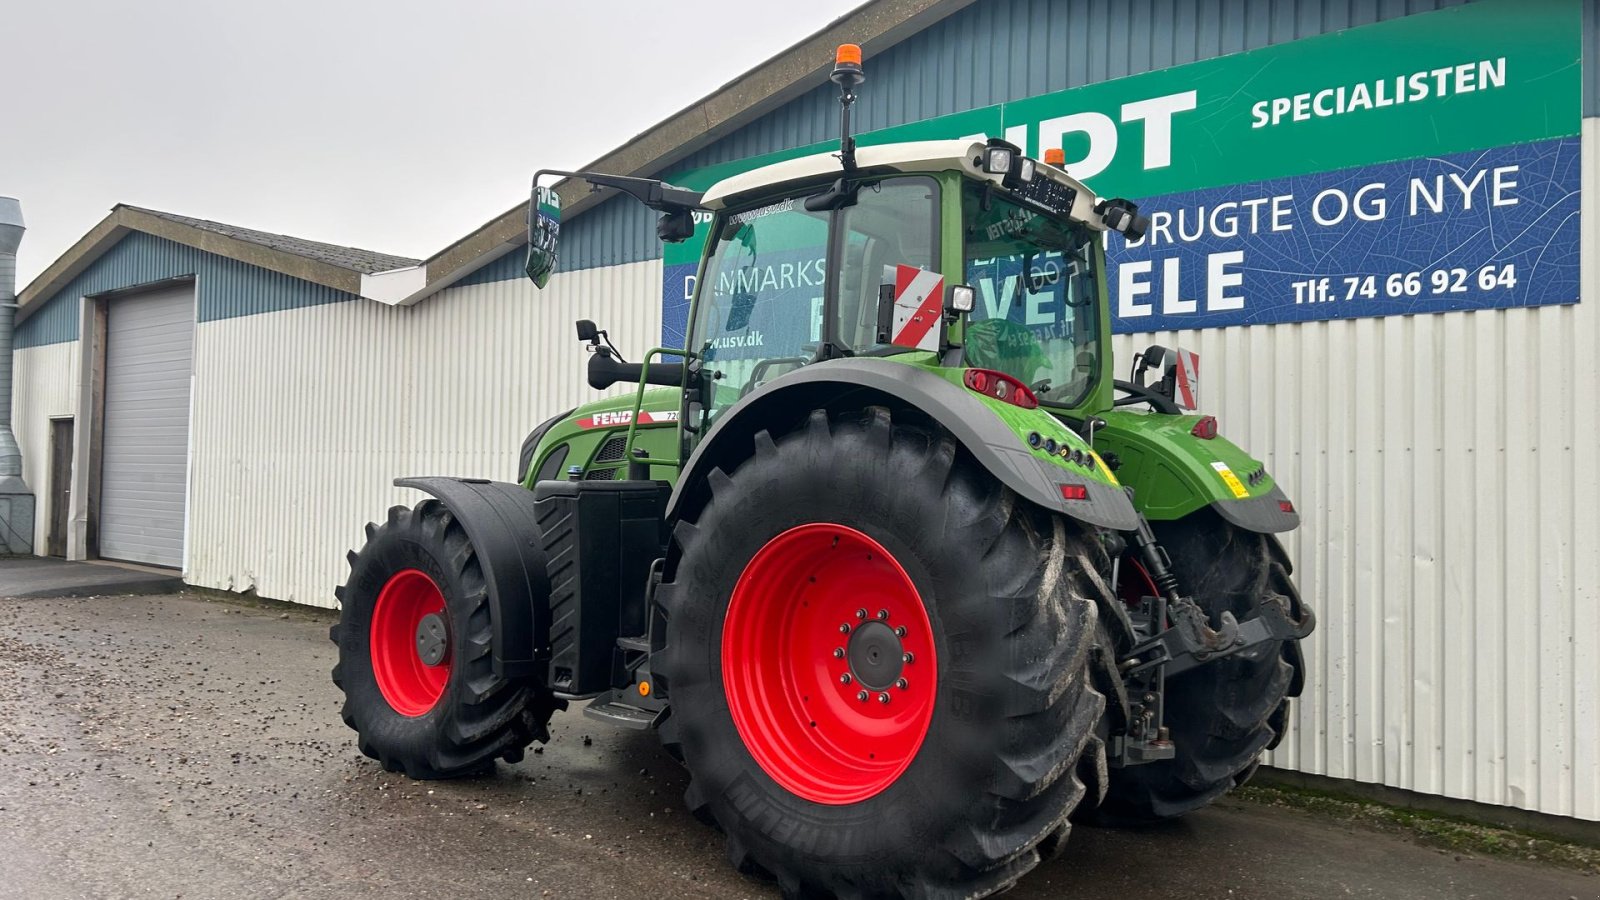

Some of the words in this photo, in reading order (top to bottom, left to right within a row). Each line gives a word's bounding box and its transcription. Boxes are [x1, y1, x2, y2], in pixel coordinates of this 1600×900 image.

[1251, 57, 1507, 128] SPECIALISTEN
[683, 257, 826, 299] DNMARKS
[1311, 182, 1387, 227] OG
[1409, 164, 1521, 217] NYE
[1291, 281, 1337, 305] Tlf.
[1344, 275, 1378, 301] 74
[1385, 272, 1422, 298] 66
[1430, 267, 1467, 294] 92
[1478, 264, 1517, 290] 64
